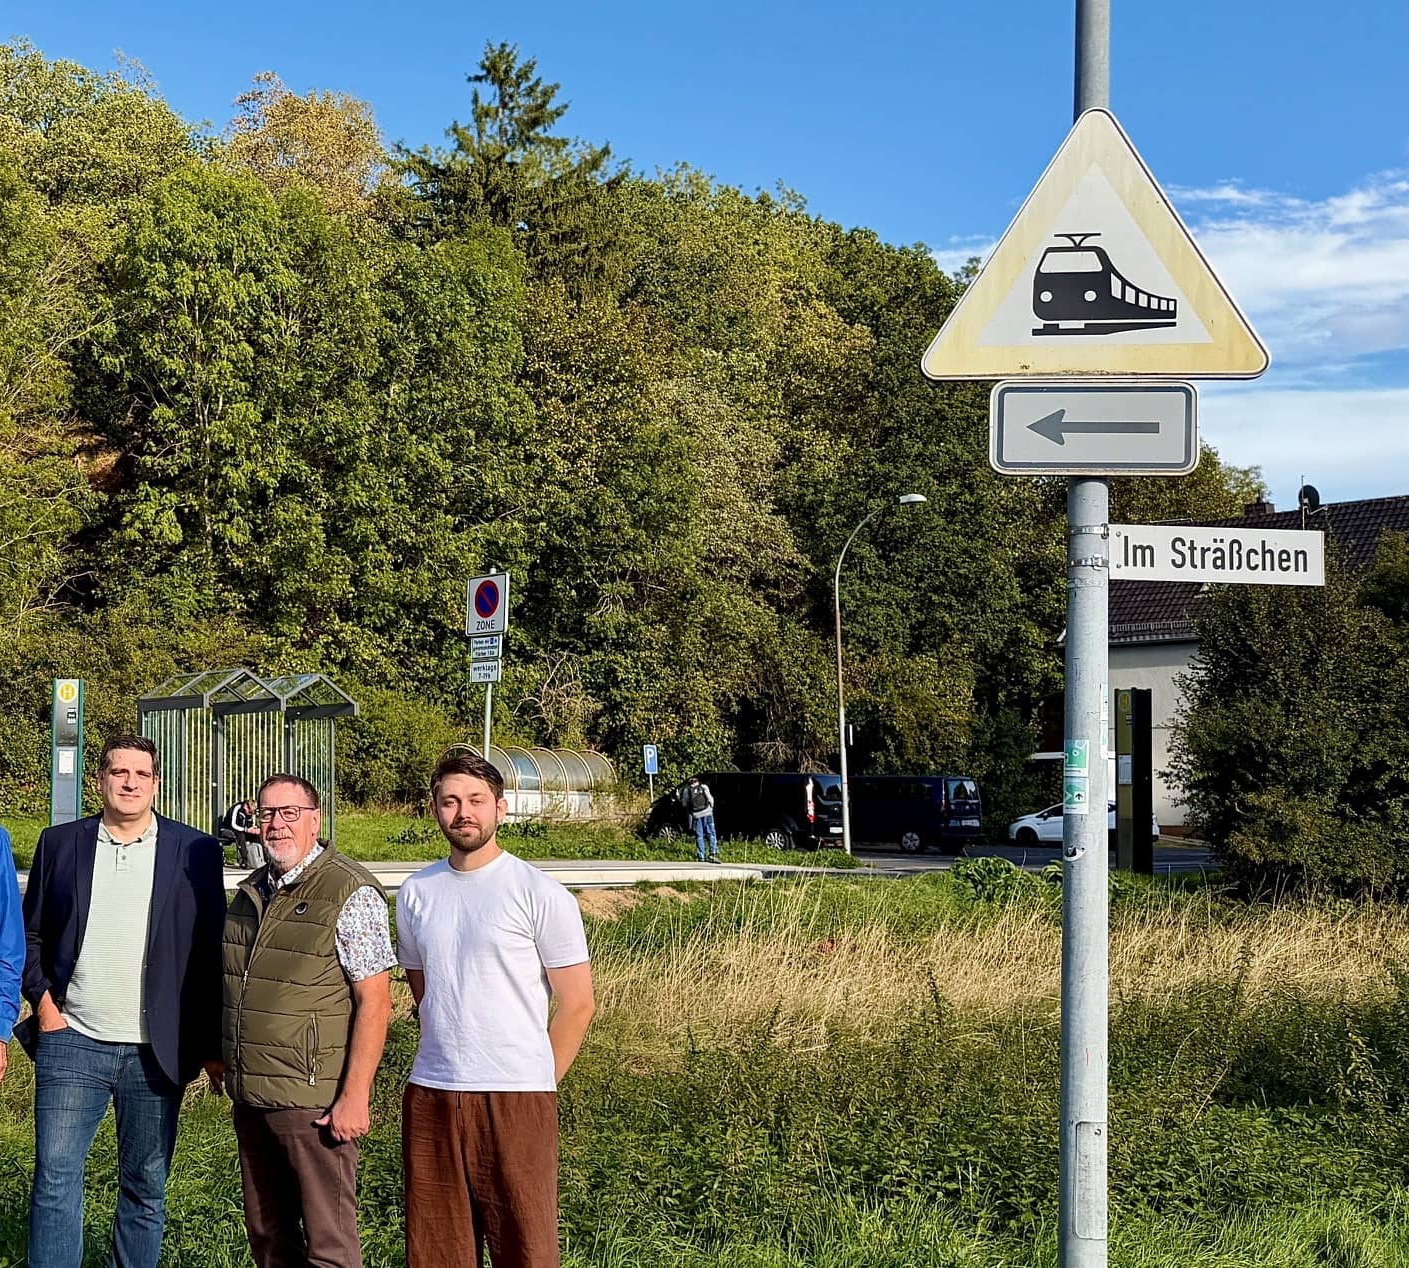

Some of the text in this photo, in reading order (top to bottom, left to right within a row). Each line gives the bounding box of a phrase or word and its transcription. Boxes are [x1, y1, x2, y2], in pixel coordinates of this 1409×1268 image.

[1123, 535, 1308, 573] Im Sträßchen
[476, 619, 495, 631] ZONE
[646, 748, 655, 765] P
